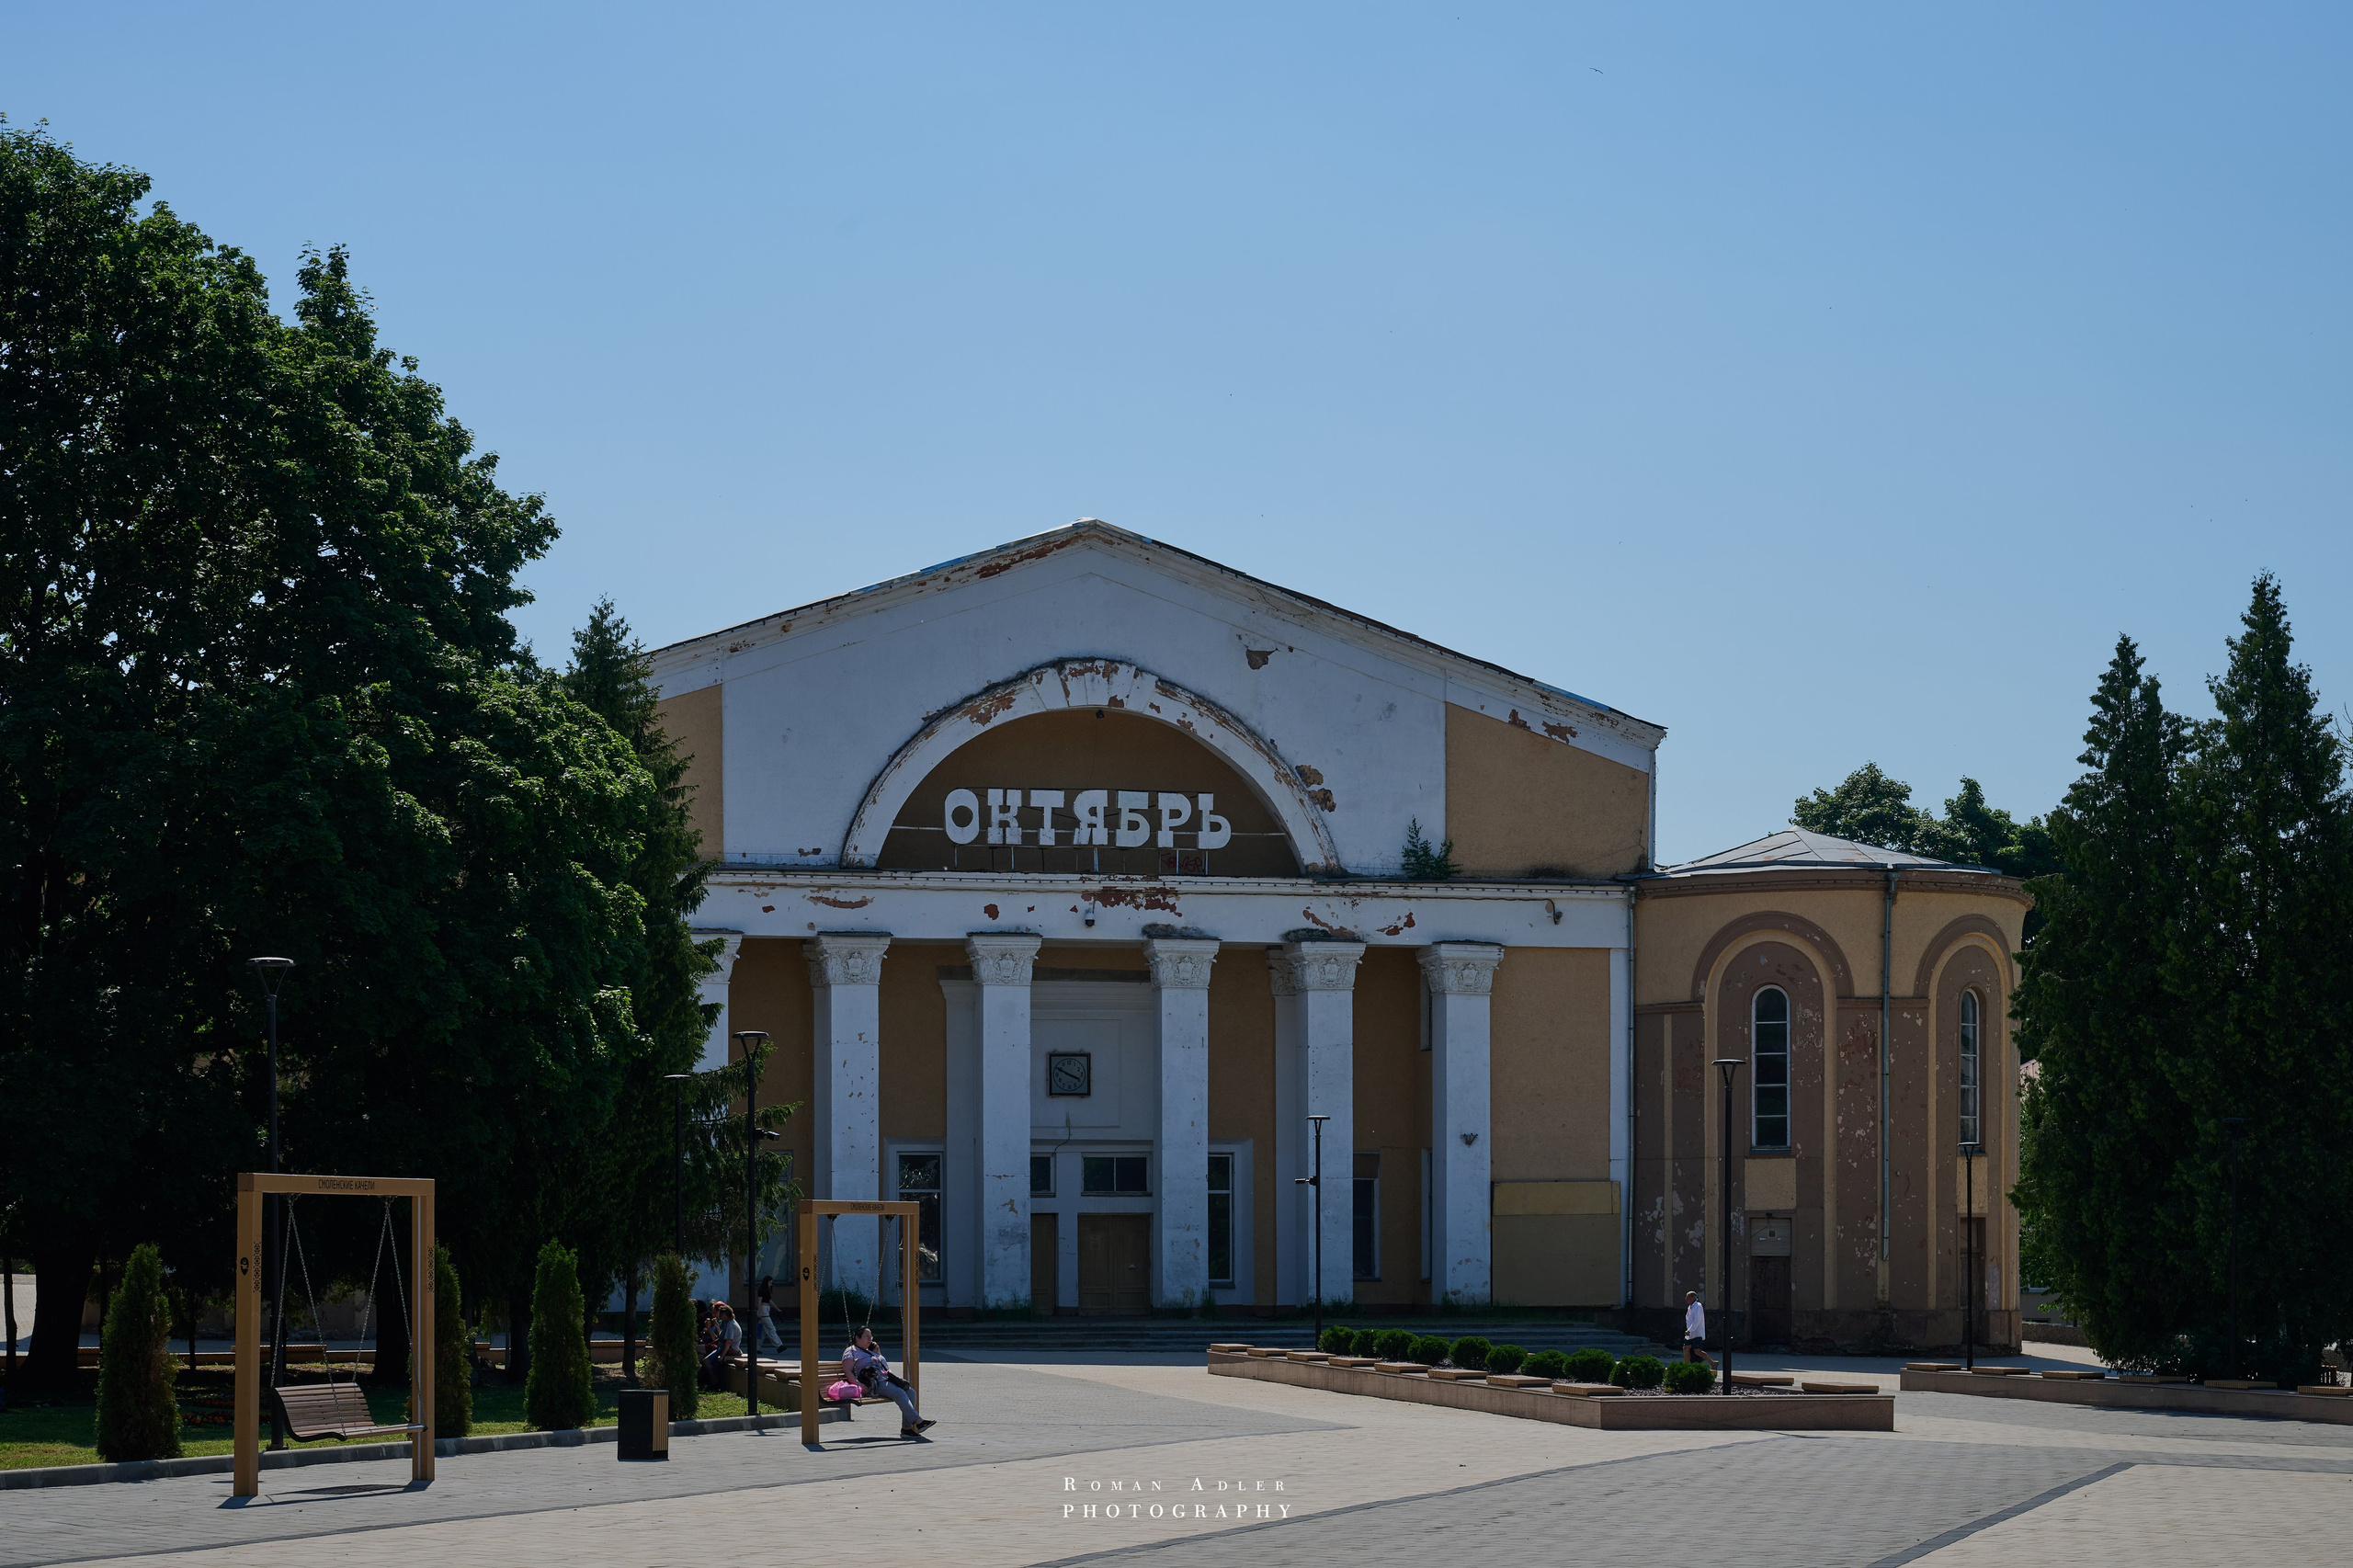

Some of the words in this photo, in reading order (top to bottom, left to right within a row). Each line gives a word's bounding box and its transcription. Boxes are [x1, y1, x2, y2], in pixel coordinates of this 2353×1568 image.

[944, 788, 1232, 849] ОКТЯБРЬ
[318, 1179, 353, 1189] СМОЛЕНСКИЕ
[355, 1180, 375, 1190] КАЧЕЛИ
